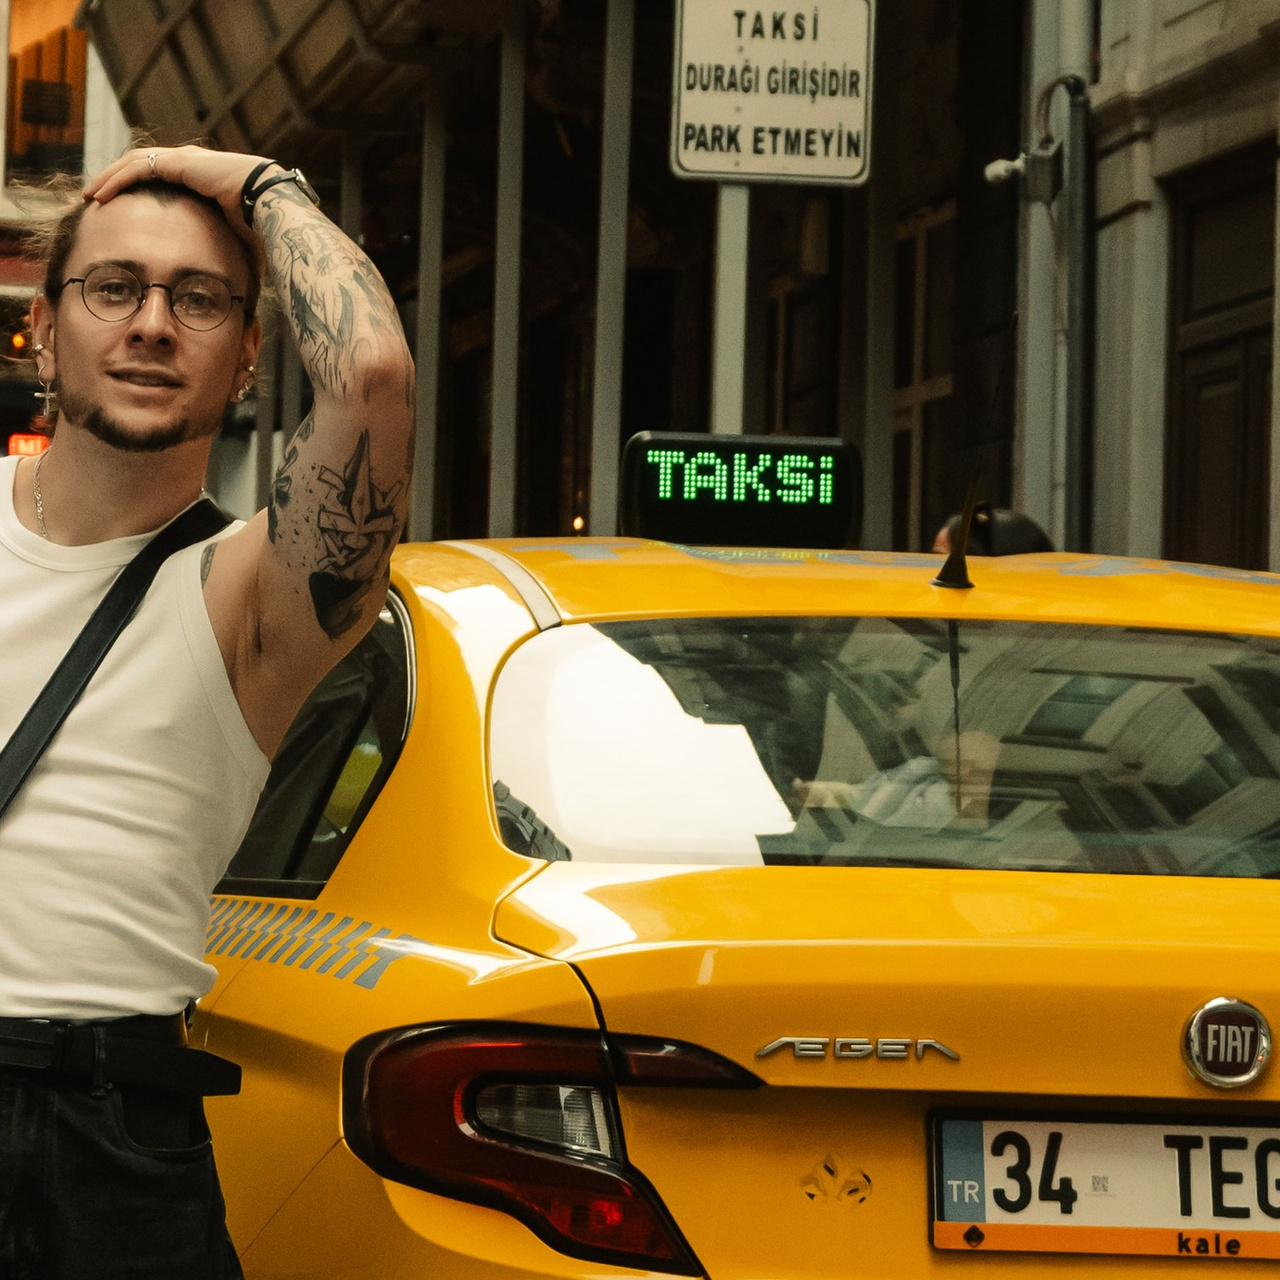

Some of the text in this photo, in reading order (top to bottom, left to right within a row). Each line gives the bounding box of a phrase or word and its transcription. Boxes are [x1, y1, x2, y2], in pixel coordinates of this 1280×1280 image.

[733, 6, 819, 41] TAKSİ
[686, 58, 861, 104] DURAĞI GİRİŞİDİR
[684, 122, 862, 158] PARK ETMEYİN
[1206, 1023, 1255, 1063] FIAT
[990, 1130, 1079, 1215] 34
[946, 1179, 981, 1204] TR
[1177, 1231, 1242, 1256] kale
